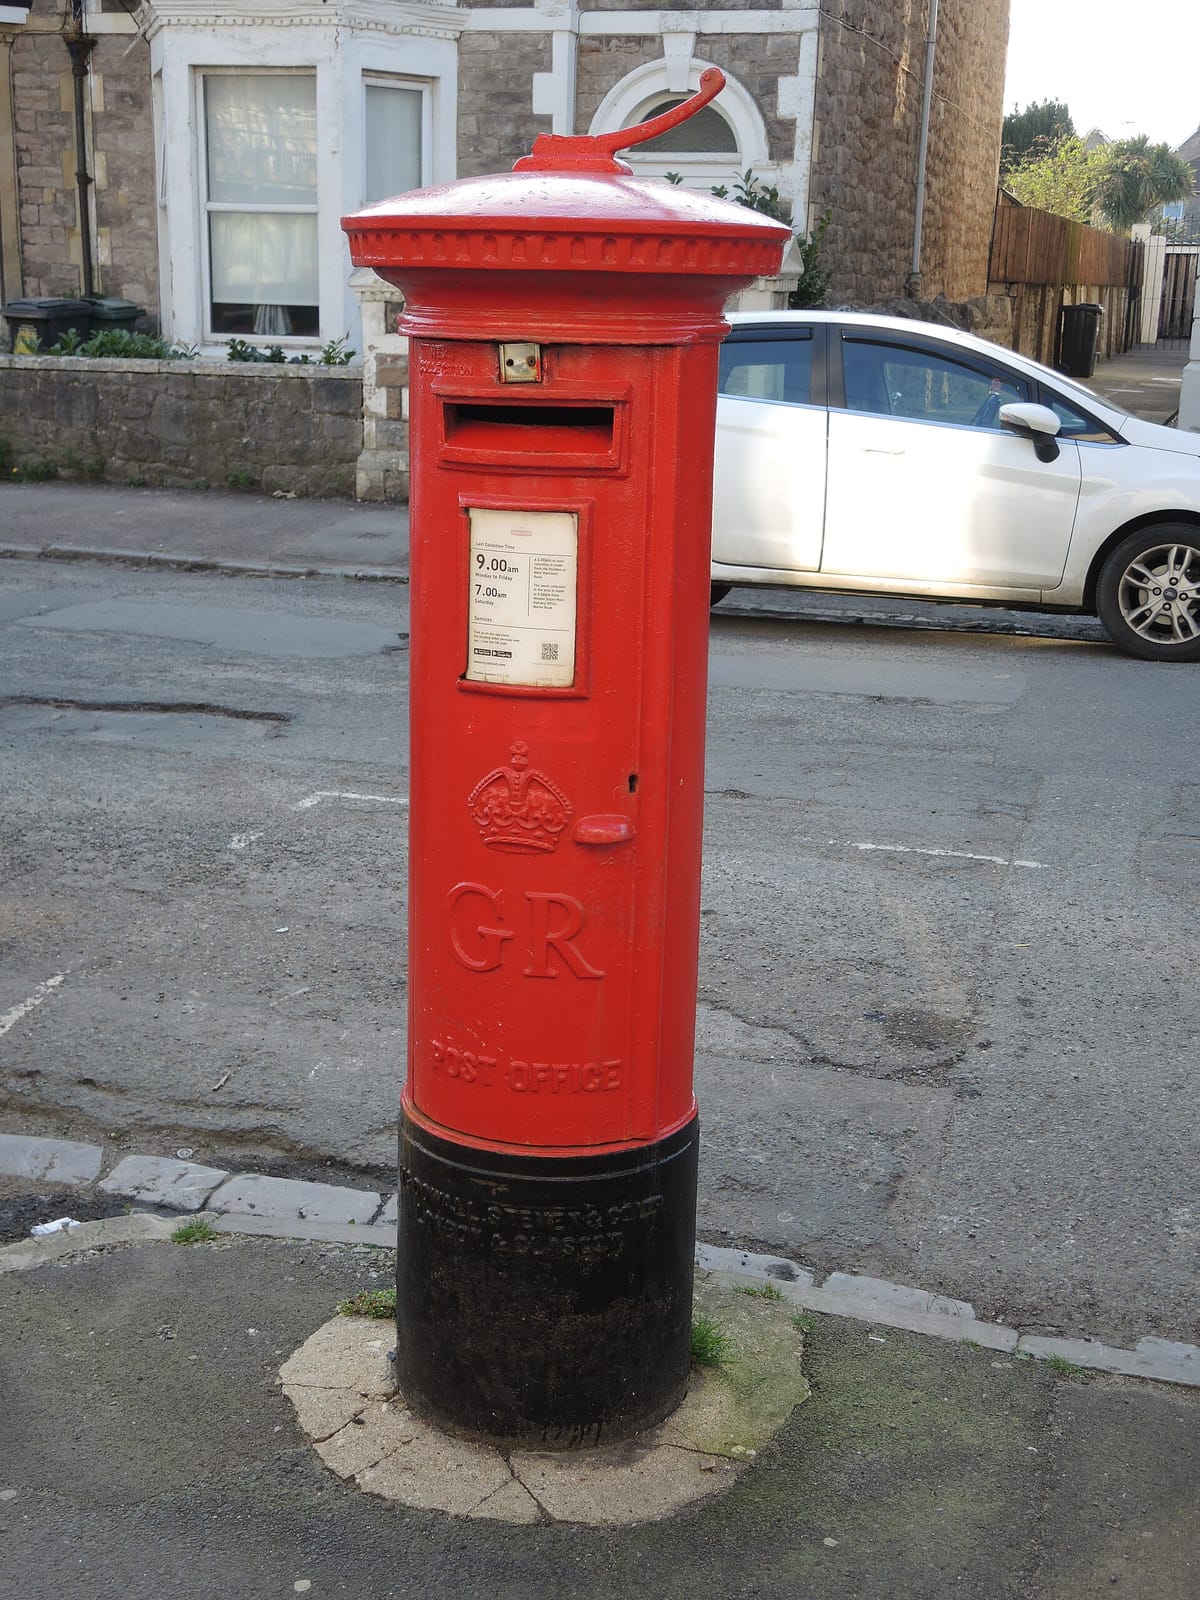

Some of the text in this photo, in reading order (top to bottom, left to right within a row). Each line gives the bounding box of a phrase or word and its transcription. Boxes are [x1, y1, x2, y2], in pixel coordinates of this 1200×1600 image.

[476, 554, 519, 573] 9.00am
[475, 584, 507, 598] 7.00am
[474, 598, 494, 606] Saturday
[431, 1038, 622, 1094] POST OFFICE
